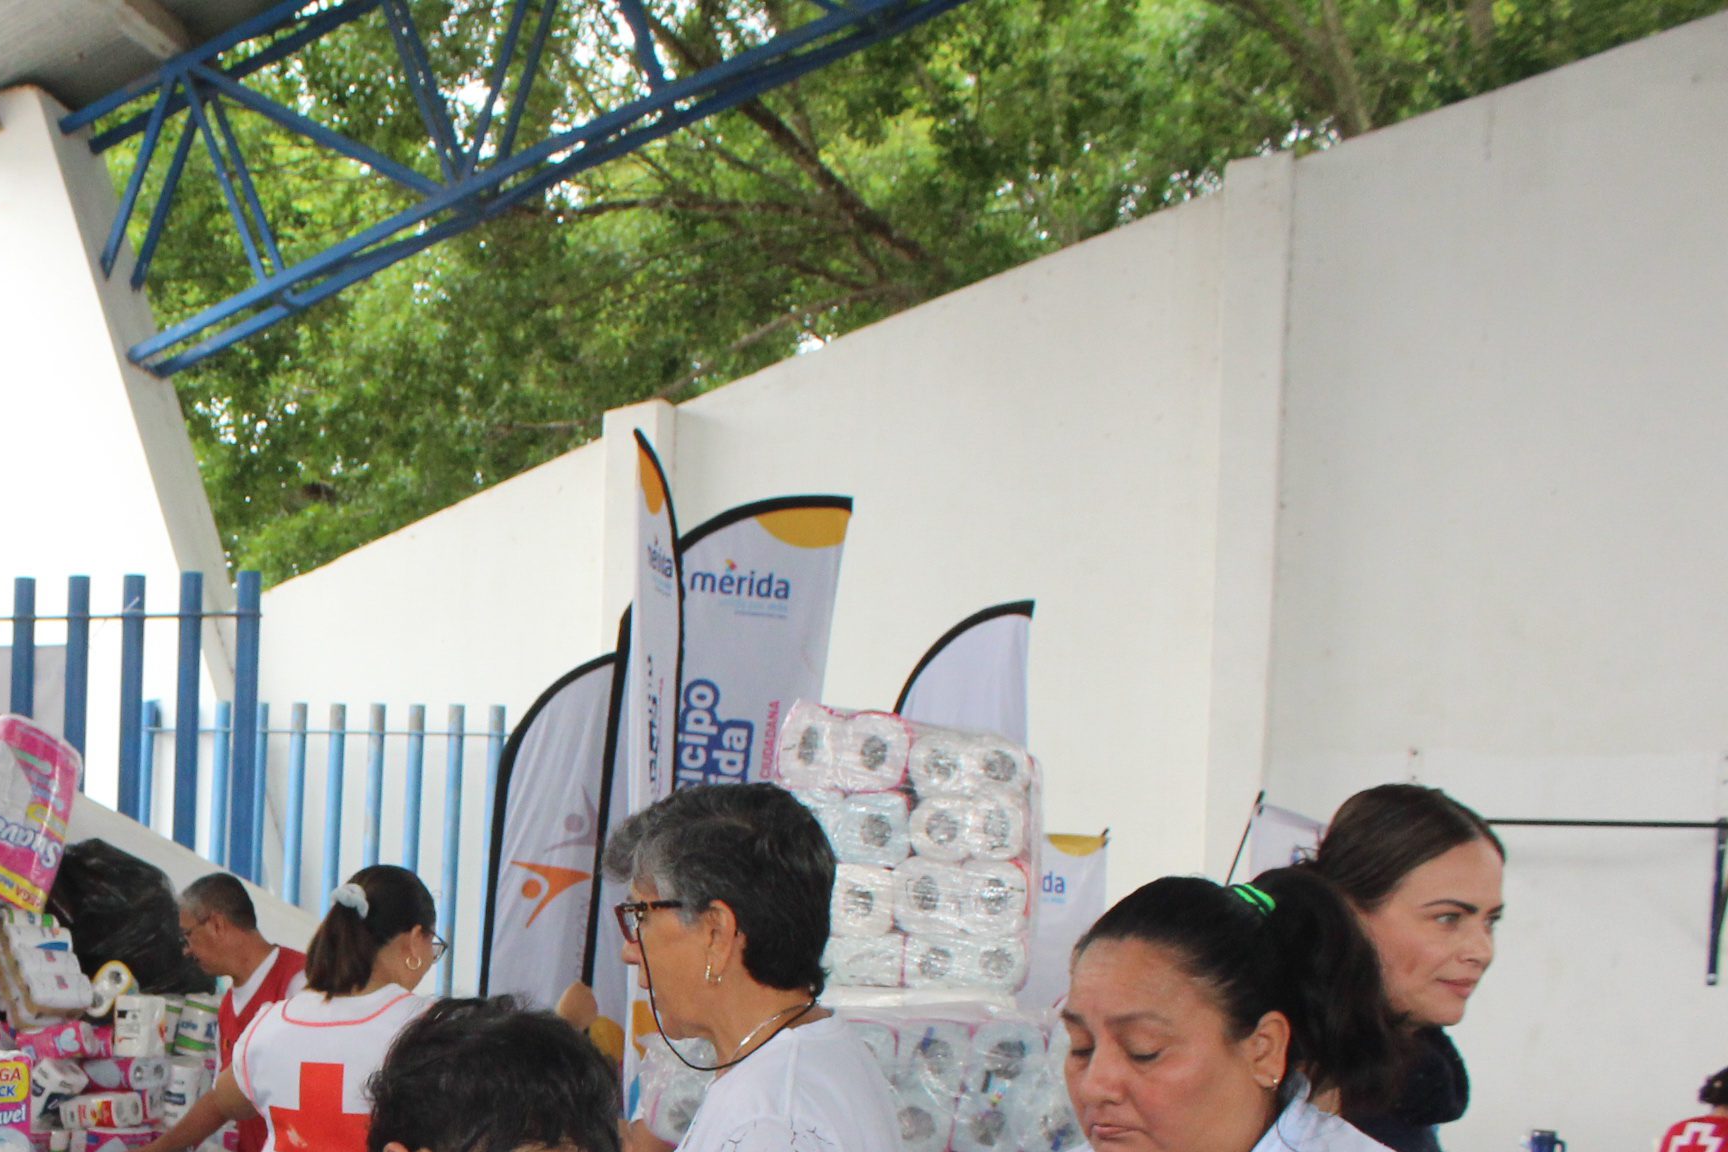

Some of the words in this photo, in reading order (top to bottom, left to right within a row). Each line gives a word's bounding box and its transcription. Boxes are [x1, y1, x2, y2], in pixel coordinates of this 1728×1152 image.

[690, 562, 791, 599] mérida
[677, 681, 719, 784] icipo
[710, 726, 749, 784] ida
